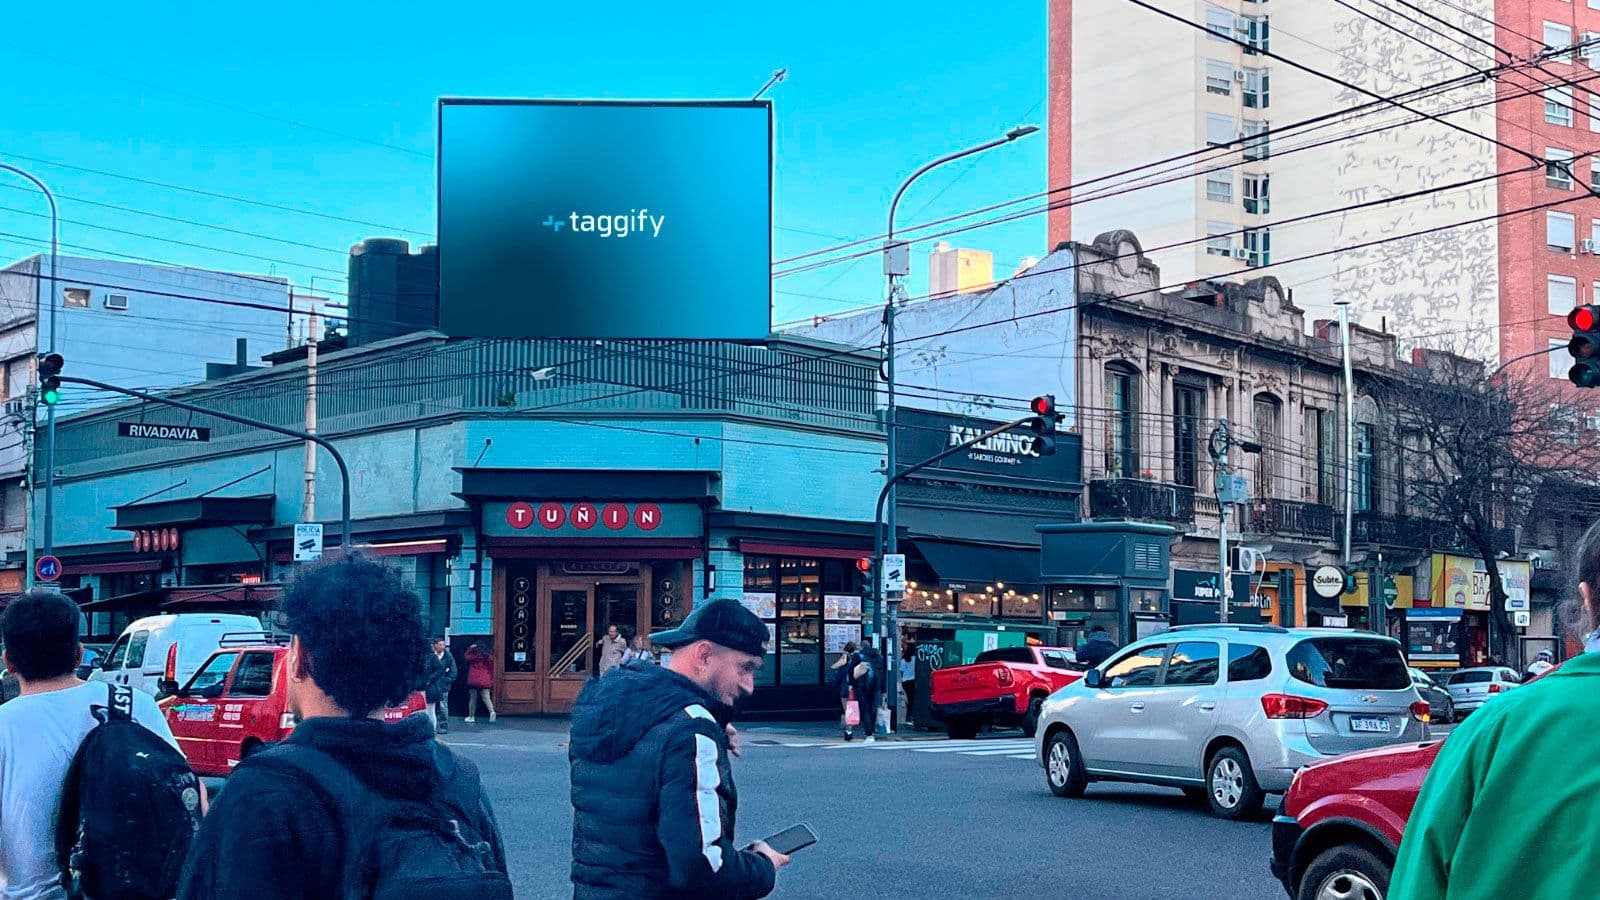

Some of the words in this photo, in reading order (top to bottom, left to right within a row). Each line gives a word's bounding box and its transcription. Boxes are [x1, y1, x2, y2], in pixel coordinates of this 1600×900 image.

[569, 208, 665, 238] taggify
[129, 424, 199, 440] RIVADAVIA
[515, 506, 653, 523] TUÑIN
[1317, 575, 1339, 584] Subte
